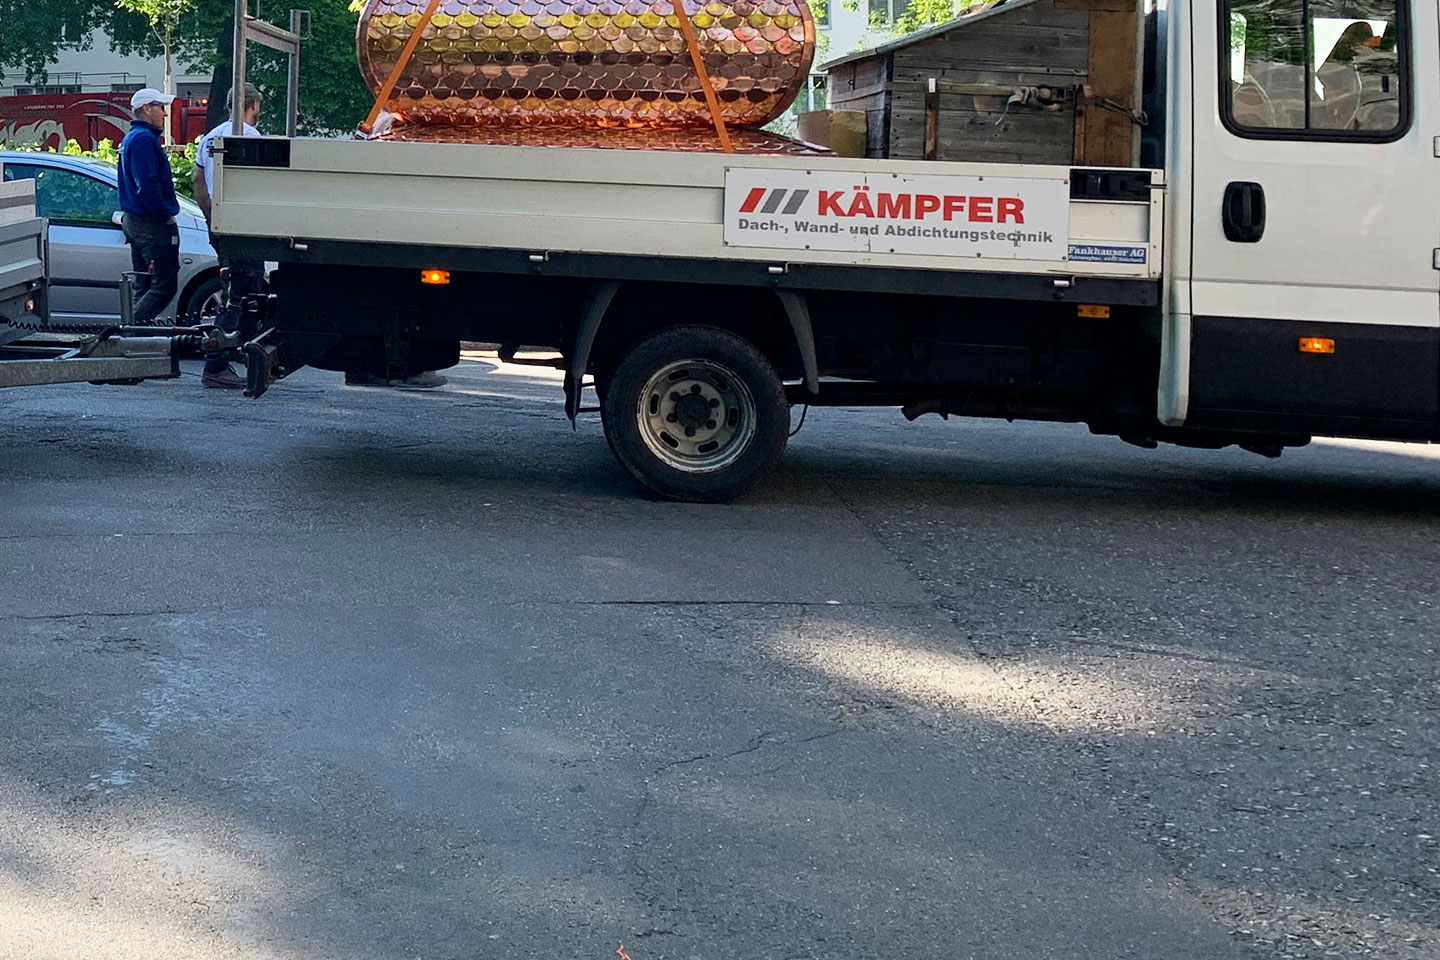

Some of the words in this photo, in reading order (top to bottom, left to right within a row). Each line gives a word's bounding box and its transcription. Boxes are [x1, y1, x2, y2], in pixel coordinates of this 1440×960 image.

[818, 185, 1025, 224] KÄMPFER
[738, 218, 789, 234] Dach-,
[794, 220, 845, 234] Wand-
[849, 223, 879, 236] und
[884, 224, 1053, 244] Abdichtungstechnik
[1068, 246, 1129, 257] Fankhauser
[1129, 248, 1145, 258] AG
